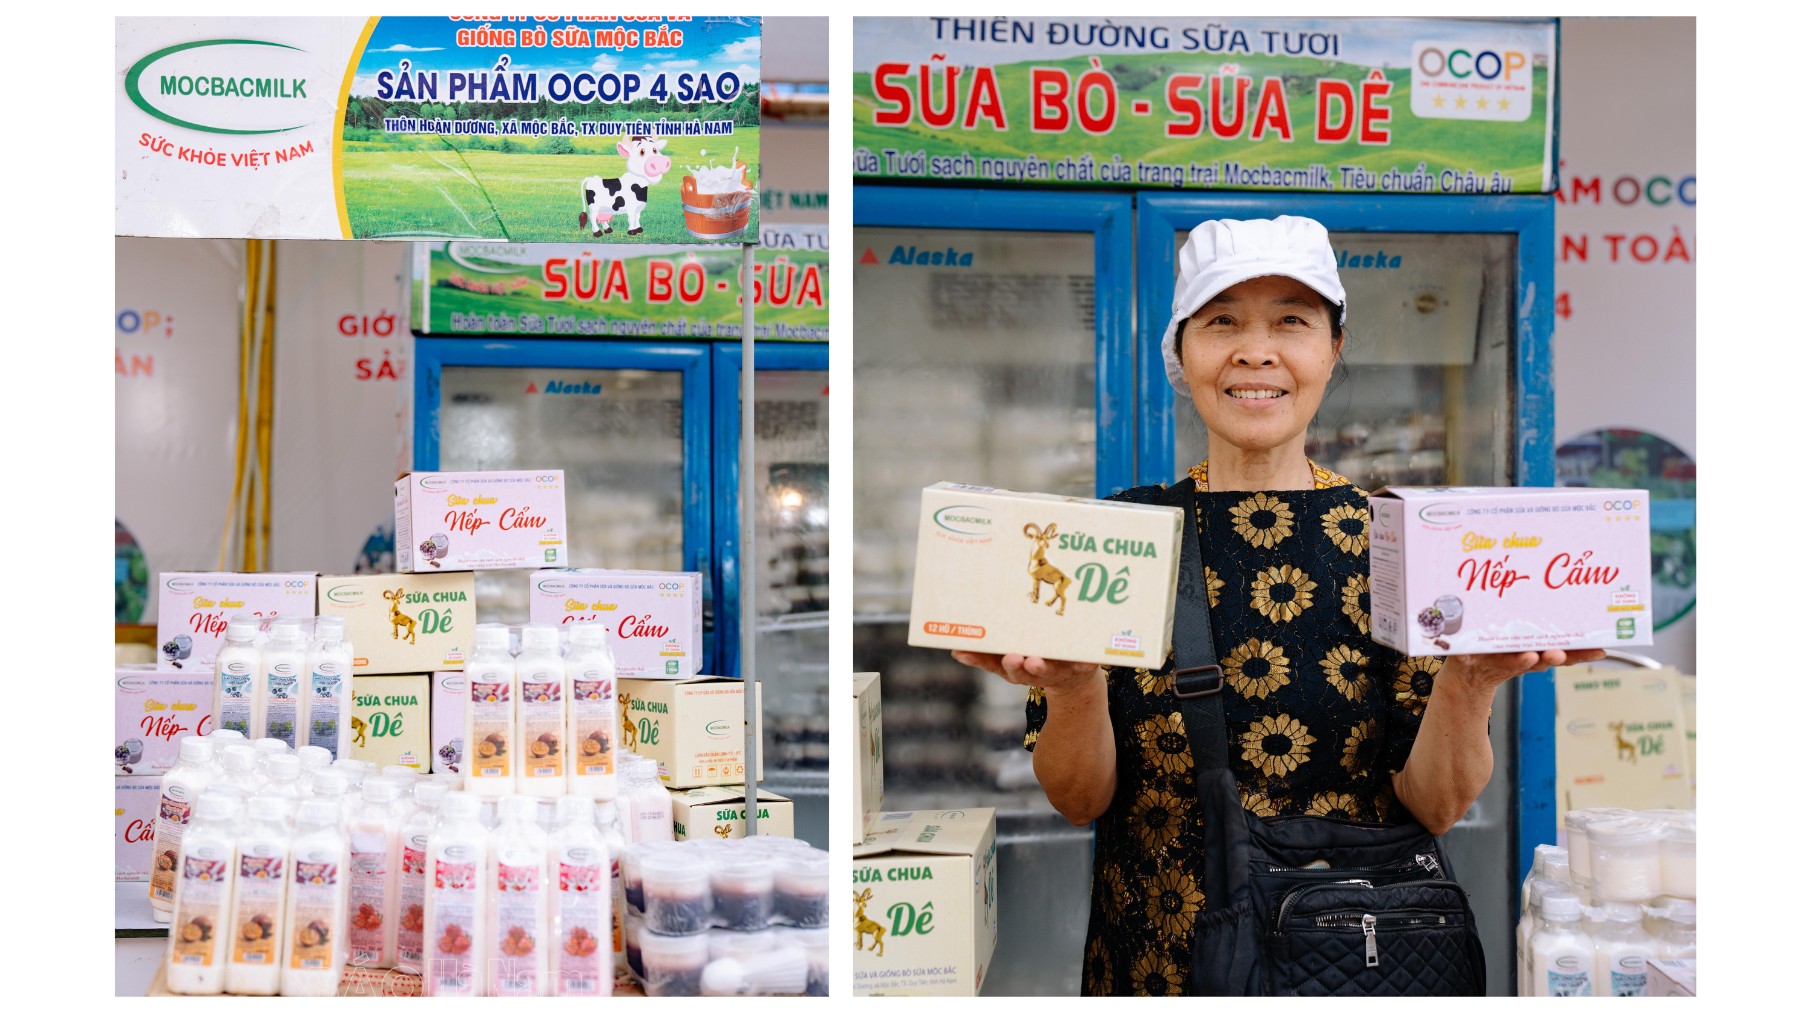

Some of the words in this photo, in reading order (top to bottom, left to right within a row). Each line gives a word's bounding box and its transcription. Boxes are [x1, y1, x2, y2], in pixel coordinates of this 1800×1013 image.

[458, 24, 515, 46] GIỐNG
[521, 26, 546, 46] BÒ
[552, 27, 589, 46] SỮA
[596, 27, 638, 50] MỘC
[644, 25, 682, 46] BẮC
[931, 16, 1034, 43] THIÊN
[1047, 20, 1169, 48] ĐƯỜNG
[1182, 24, 1249, 52] SỮA
[1261, 30, 1339, 56] TƯƠI
[1419, 47, 1526, 81] OCOP
[160, 75, 307, 98] MOCBACMILK
[377, 61, 437, 100] SẢN
[450, 56, 536, 101] PHẨM
[548, 73, 641, 101] OCOP
[650, 73, 668, 100] 4
[677, 71, 740, 101] SAO
[875, 53, 1006, 128] SỮA
[1032, 57, 1116, 134] BÒ
[1134, 101, 1150, 114] -
[1167, 64, 1292, 140] SỮA
[1317, 70, 1391, 144] DÊ
[385, 117, 416, 132] THÔN
[455, 120, 498, 136] DƯƠNG,
[502, 118, 518, 135] XÃ
[521, 119, 547, 137] MỘC
[551, 117, 578, 136] BẮC,
[582, 122, 596, 135] TX
[600, 122, 622, 135] DUY
[625, 119, 651, 135] TIÊN
[655, 118, 681, 135] TỈNH
[685, 118, 701, 135] HÀ
[705, 121, 733, 135] NAM
[139, 132, 174, 157] SỨC
[178, 147, 227, 167] KHỎE
[231, 149, 271, 171] VIỆT
[275, 140, 314, 164] NAM
[853, 148, 878, 173] ữa
[885, 151, 926, 174] Tươi
[931, 151, 976, 177] sạch
[981, 154, 1049, 183] nguyên
[1056, 154, 1095, 182] chất
[1100, 155, 1131, 183] của
[1139, 164, 1183, 187] trang
[1190, 163, 1219, 187] trại
[1224, 162, 1333, 189] Mocbacmilk,
[1340, 165, 1376, 189] Tiêu
[1382, 163, 1434, 192] chuẩn
[1440, 169, 1485, 193] Châu
[1490, 172, 1512, 193] âu
[757, 229, 796, 249] ỮA
[1603, 224, 1696, 263] TOÀ
[888, 245, 974, 267] Alaska
[544, 251, 629, 300] SỮA
[649, 252, 704, 303] BÒ
[739, 256, 822, 306] SỮA
[338, 308, 397, 337] GIỚ
[355, 350, 398, 380] SẢ
[545, 381, 602, 395] Alaska
[536, 475, 559, 483] OCOP
[1603, 499, 1641, 511] OCOP
[444, 508, 490, 536] Nếp
[499, 506, 547, 531] Cẩm
[1058, 531, 1098, 553] SỮA
[1103, 537, 1157, 559] CHUA
[1461, 530, 1497, 553] Sữa
[1502, 531, 1543, 549] chua
[284, 580, 309, 588] OCOP
[658, 582, 684, 590] OCOP
[1074, 562, 1131, 605] Dê
[1457, 554, 1530, 598] Nếp
[1544, 550, 1619, 590] Cẩm
[406, 591, 429, 604] SỮA
[433, 591, 467, 603] CHUA
[418, 608, 454, 635] Dê
[618, 614, 669, 639] Cẩm
[357, 694, 381, 706] SỮA
[384, 695, 418, 706] CHUA
[631, 698, 646, 712] SỮA
[647, 701, 669, 714] CHUA
[140, 714, 188, 741] Nếp
[369, 711, 404, 738] Dê
[638, 717, 660, 746] Dê
[716, 808, 738, 821] SỮA
[741, 808, 770, 820] CUA
[853, 866, 883, 883] SỮA
[887, 866, 933, 882] CHUA
[887, 901, 935, 937] Dê
